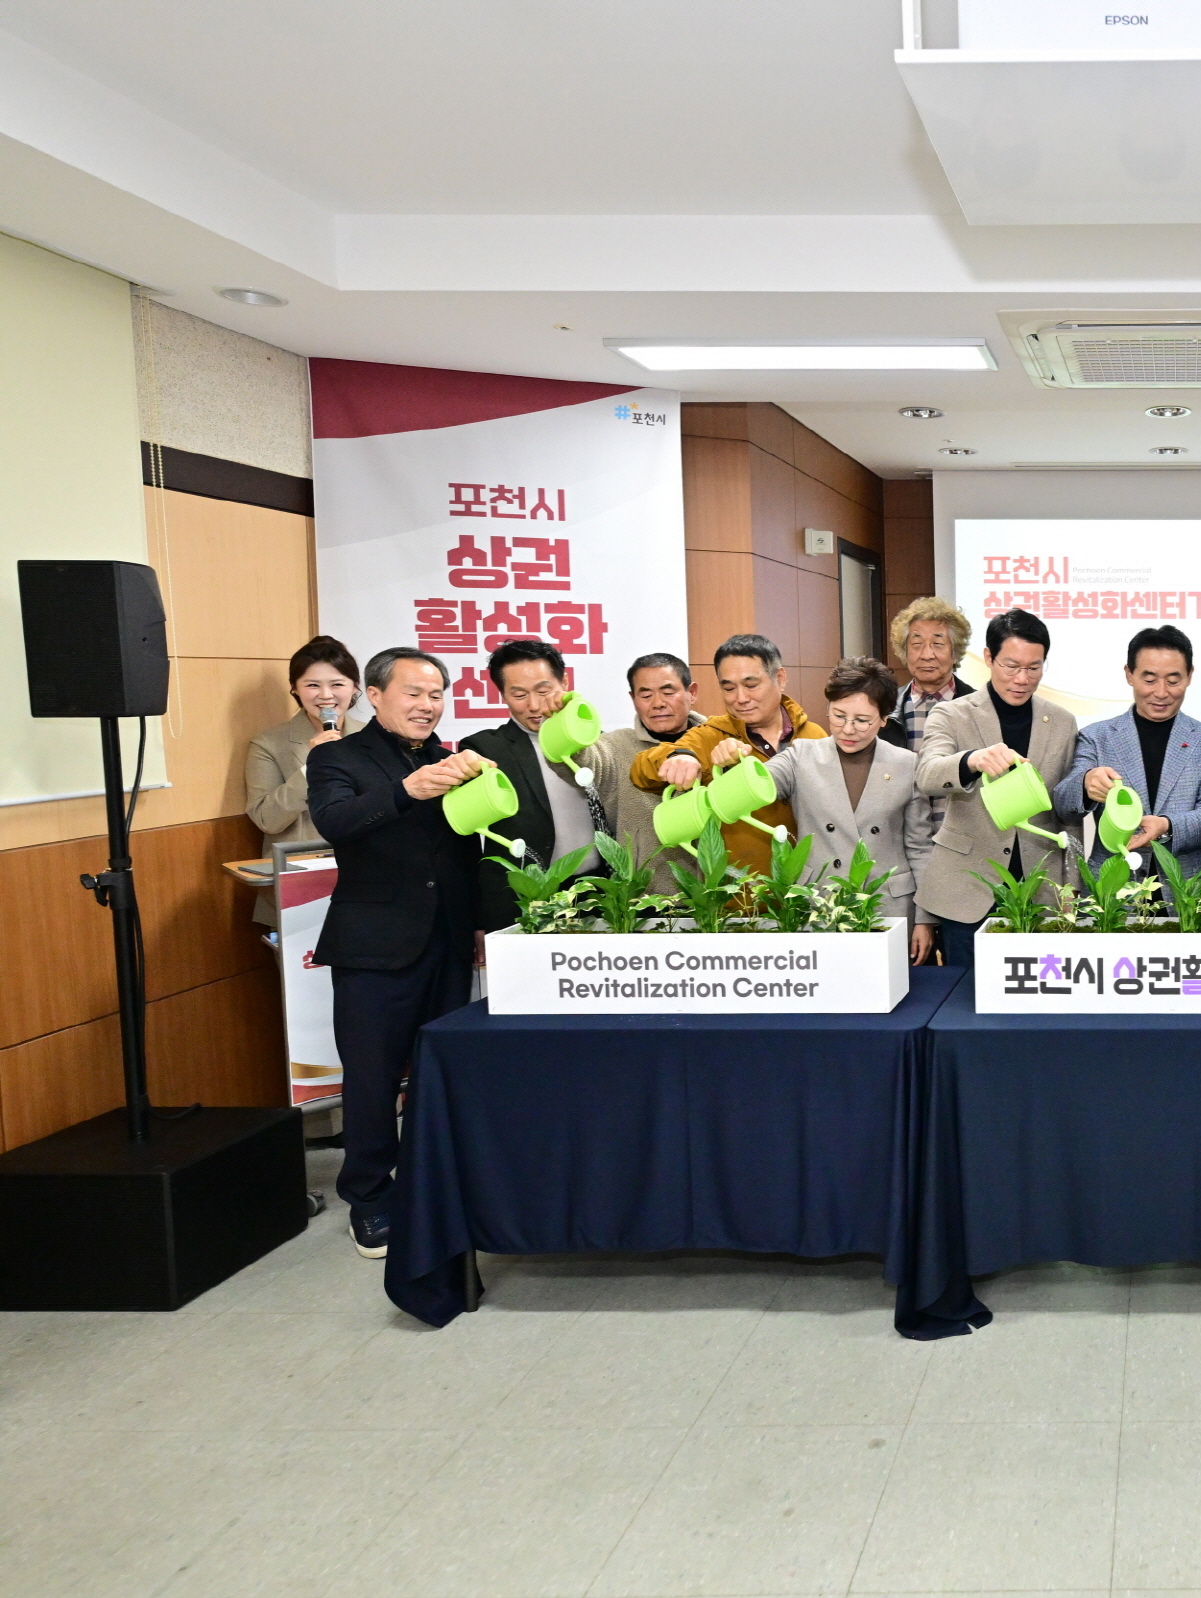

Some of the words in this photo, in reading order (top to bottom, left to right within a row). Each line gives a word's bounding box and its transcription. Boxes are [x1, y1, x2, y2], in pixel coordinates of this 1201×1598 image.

[1105, 15, 1149, 26] EPSON
[632, 412, 666, 426] 포천시
[448, 482, 566, 522] 포천시
[447, 534, 571, 591] 상권
[983, 555, 1069, 585] 포천시
[1107, 566, 1152, 574] Commercial
[1072, 576, 1123, 584] Revitalization
[1125, 576, 1149, 584] Center
[414, 597, 608, 655] 활성화
[551, 951, 659, 971] Pochoen
[665, 950, 818, 971] Commercial
[1004, 953, 1104, 995] 포천시
[558, 977, 727, 999] Revitalization
[733, 977, 819, 998] Center
